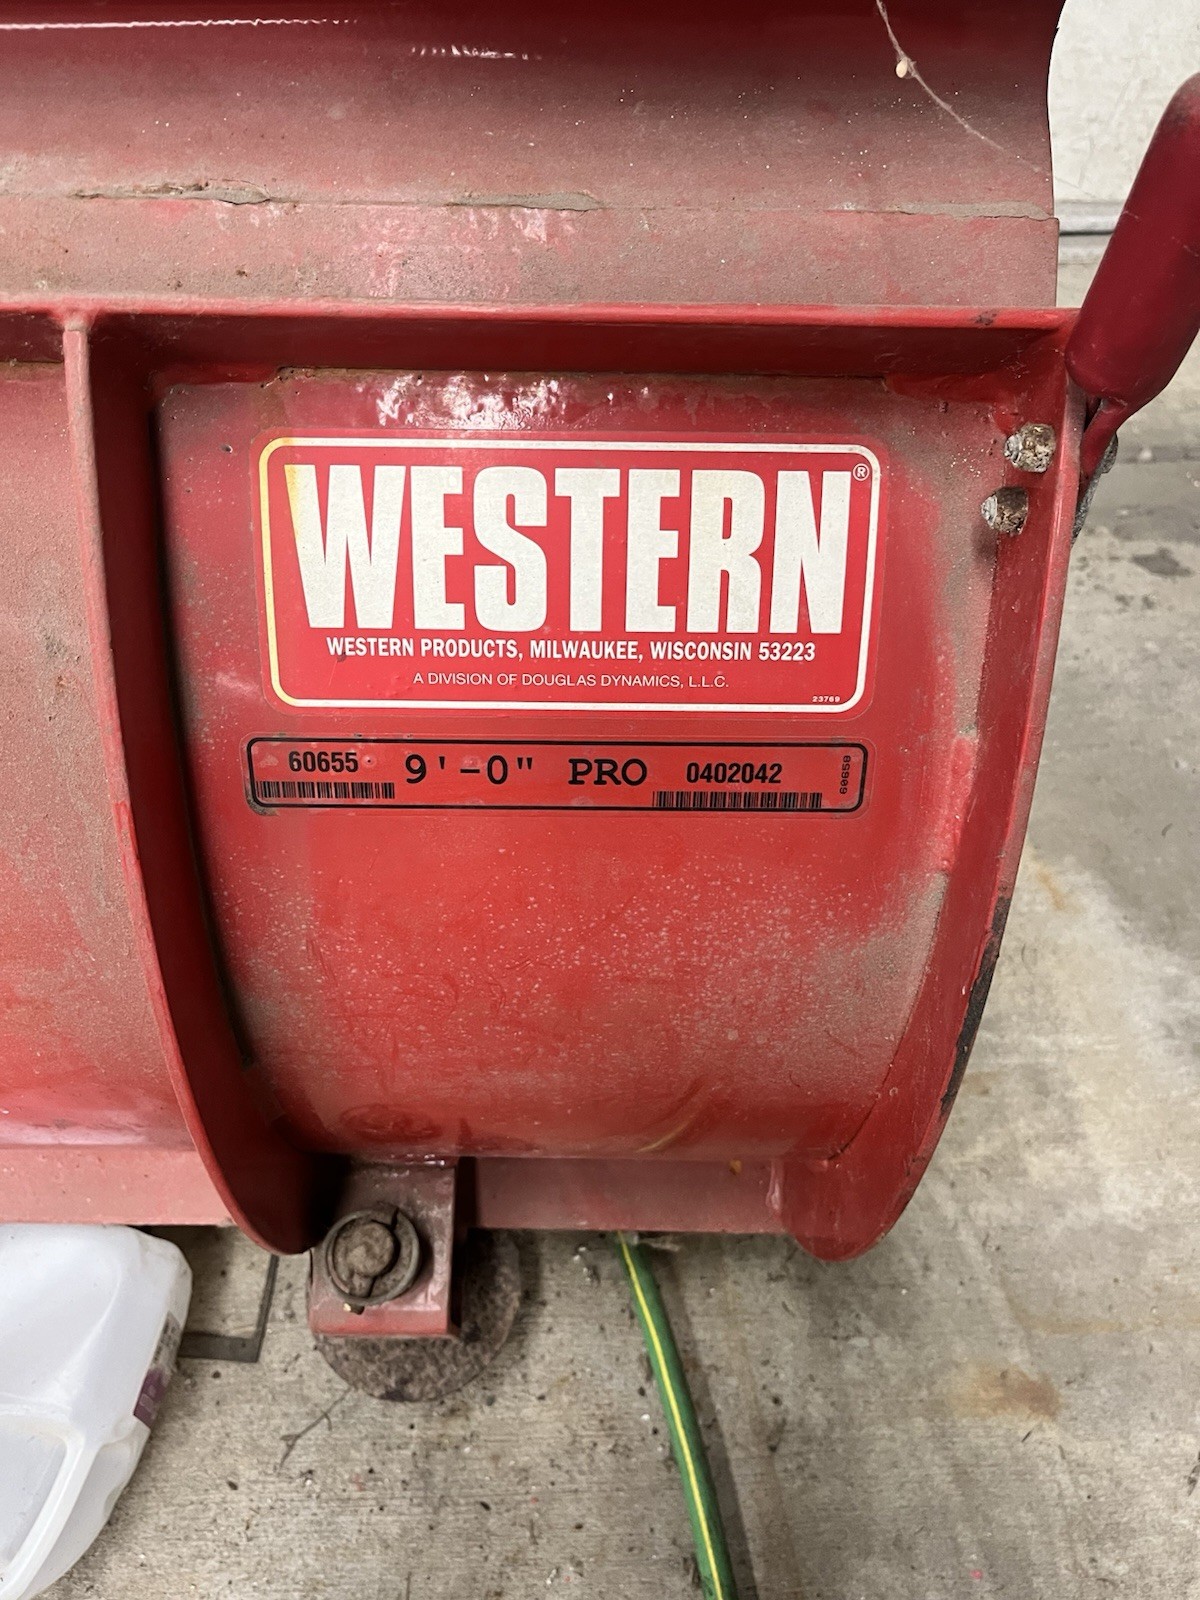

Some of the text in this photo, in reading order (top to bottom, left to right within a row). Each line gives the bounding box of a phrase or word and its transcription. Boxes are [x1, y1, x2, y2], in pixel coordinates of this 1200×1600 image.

[284, 463, 852, 634] WESTERN
[327, 636, 816, 663] WESTERN PRODUCTS, MILWAUKEE, WISCONSIN 53223
[412, 672, 730, 689] A DIVISION OF DOUGLAS DYNAMICS, L.L.C.
[812, 695, 841, 703] 23769
[288, 751, 359, 773] 60655
[567, 757, 648, 786] PRO
[686, 762, 783, 785] 0402042
[839, 754, 852, 795] 60658
